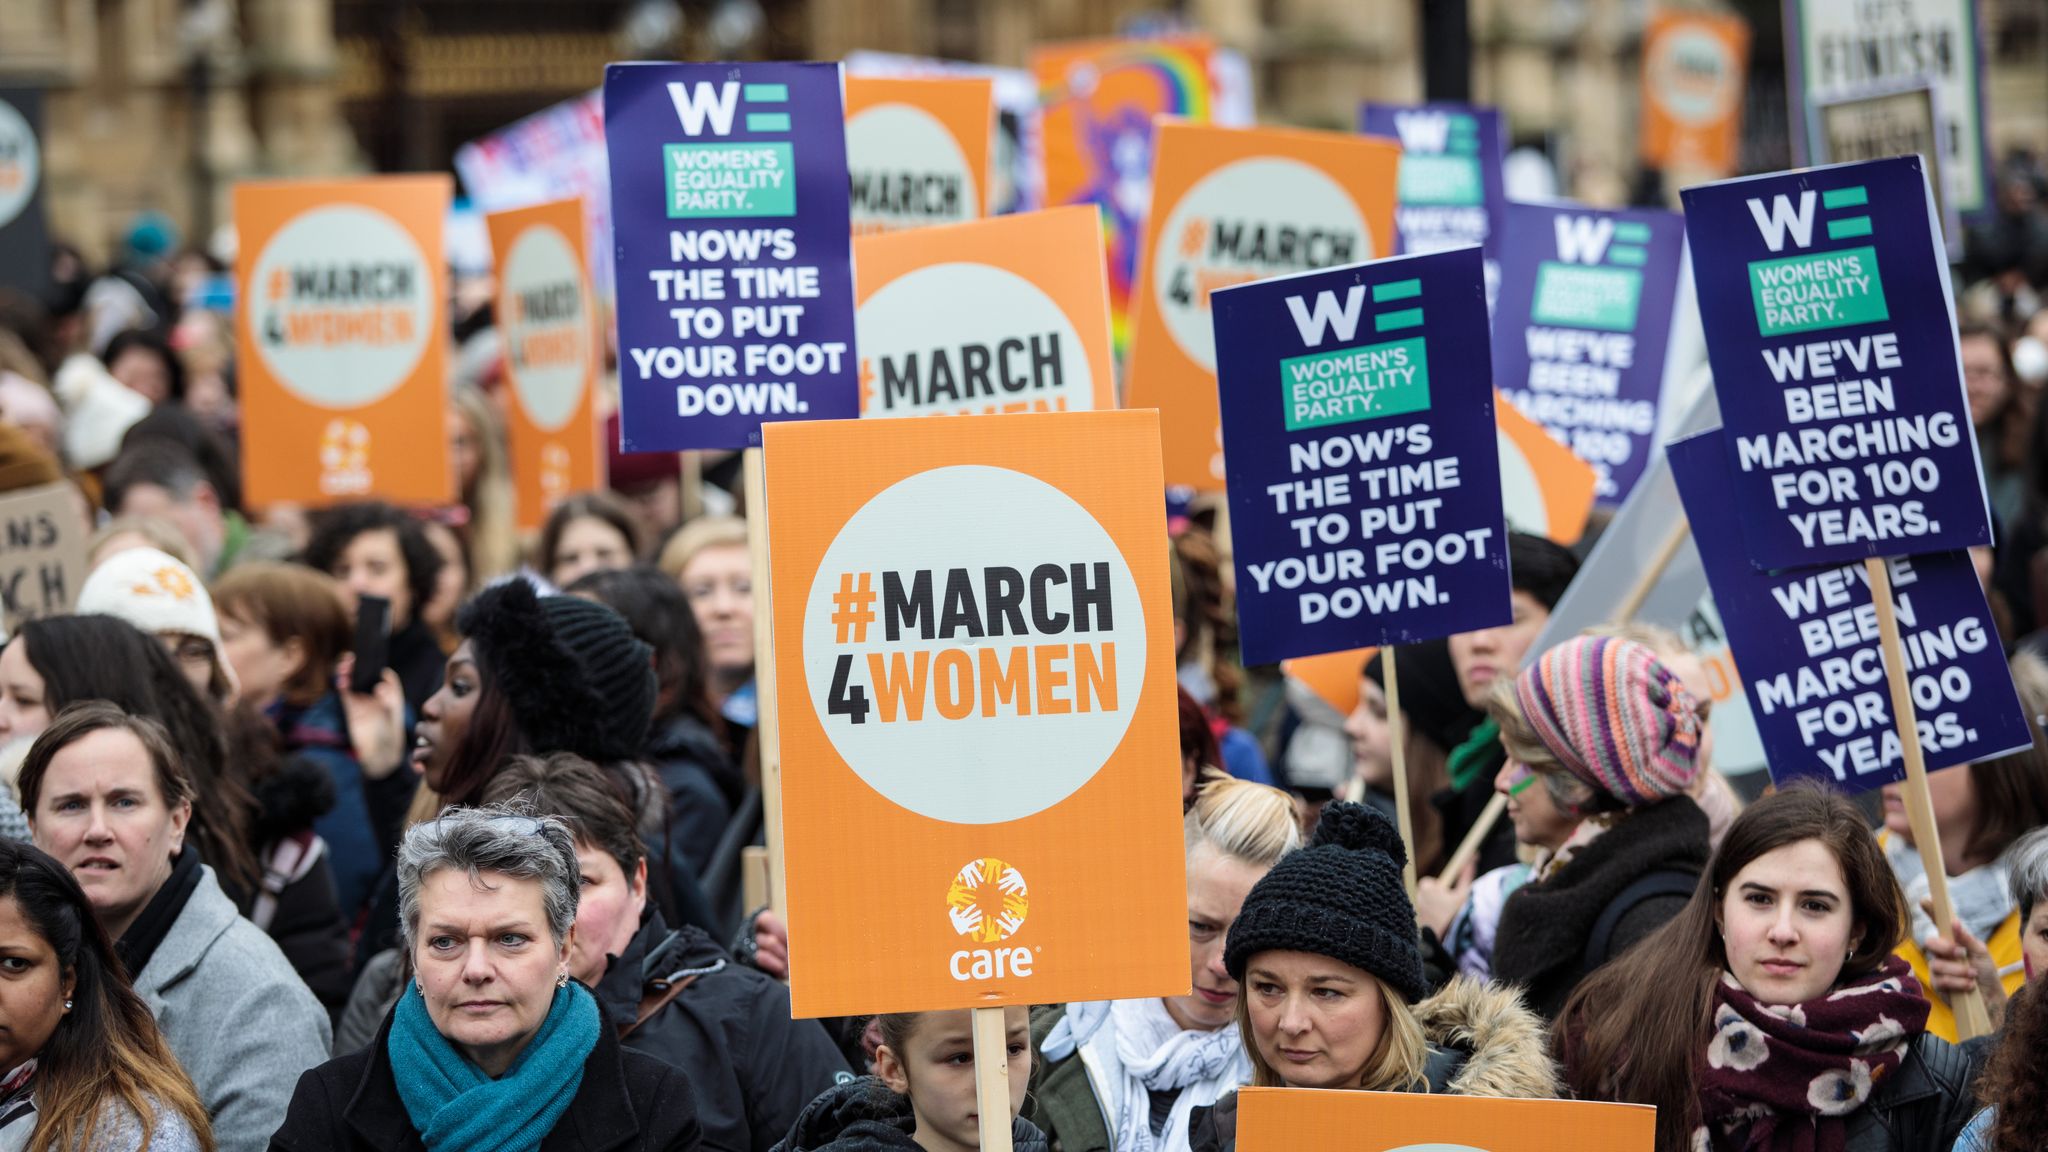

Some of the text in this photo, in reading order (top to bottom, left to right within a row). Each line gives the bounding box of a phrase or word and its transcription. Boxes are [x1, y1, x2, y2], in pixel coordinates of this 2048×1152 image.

[672, 149, 778, 170] WOMEN'S
[674, 169, 784, 190] EQUALITY
[675, 190, 753, 210] PARTY.
[670, 228, 797, 262] NOW'S
[267, 263, 416, 301] #MARCH
[649, 266, 820, 301] THE TIME
[1758, 256, 1862, 287] WOMEN'S
[1760, 276, 1870, 309] EQUALITY
[670, 305, 804, 339] TO PUT
[1764, 303, 1844, 328] PARTY.
[630, 342, 847, 379] YOUR FOOT
[1291, 347, 1408, 383] WOMEN'S
[1525, 326, 1636, 369] WE'VE
[1761, 332, 1902, 383] WE'VE
[1292, 365, 1416, 402] EQUALITY
[1528, 360, 1621, 397] BEEN
[677, 382, 809, 417] DOWN.
[1295, 393, 1381, 422] PARTY.
[1784, 376, 1896, 424] BEEN
[1289, 423, 1432, 473] NOW'S
[1736, 411, 1960, 472] MARCHING
[1267, 457, 1460, 514] THE TIME
[1771, 457, 1940, 509] FOR 100
[1291, 498, 1442, 548] TO PUT
[1788, 500, 1941, 548] YEARS.
[1247, 528, 1492, 593] YOUR FOOT
[831, 561, 1114, 644] #MARCH
[1299, 575, 1449, 624] DOWN.
[1799, 593, 1917, 658] BEEN
[828, 642, 1119, 724] 4WOMEN
[1796, 691, 1889, 746] FOR
[1817, 712, 1978, 782] YEARS.
